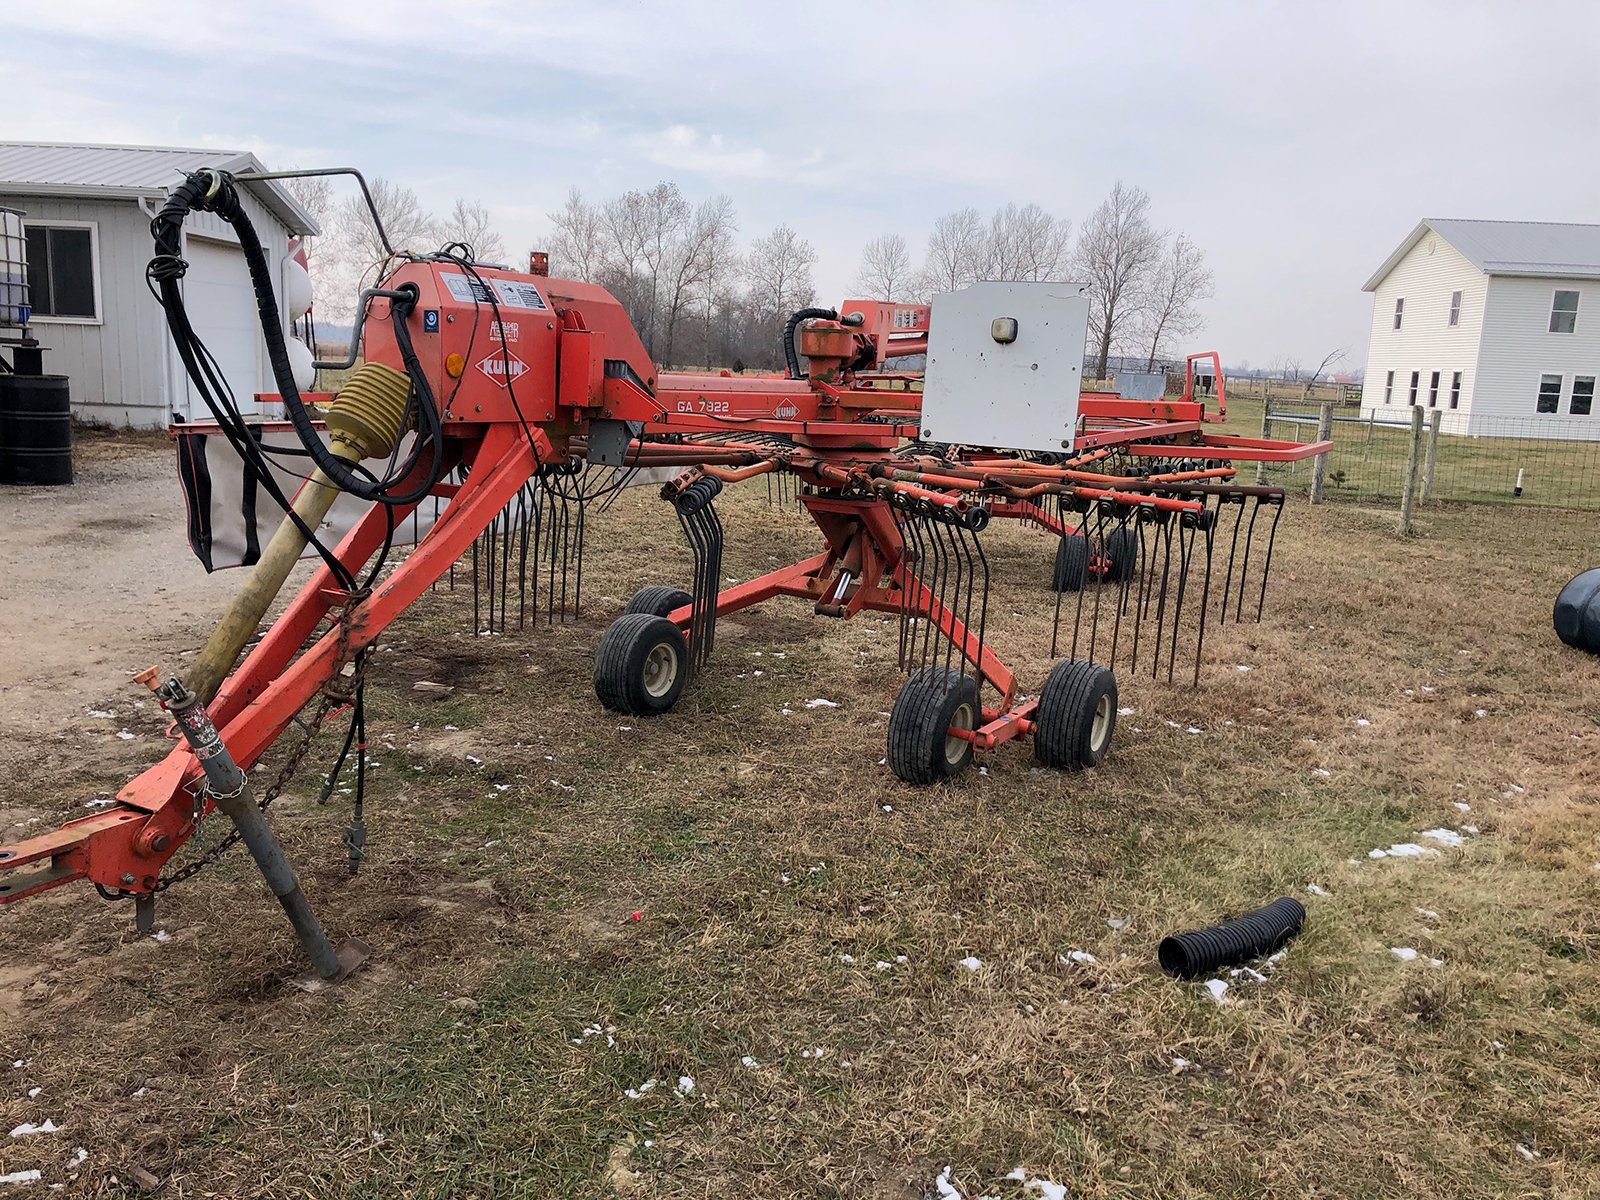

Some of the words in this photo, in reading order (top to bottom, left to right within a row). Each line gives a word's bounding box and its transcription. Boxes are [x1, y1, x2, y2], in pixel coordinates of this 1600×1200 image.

[677, 401, 693, 412] GA
[698, 401, 729, 412] 7822
[775, 406, 796, 417] KUHN
